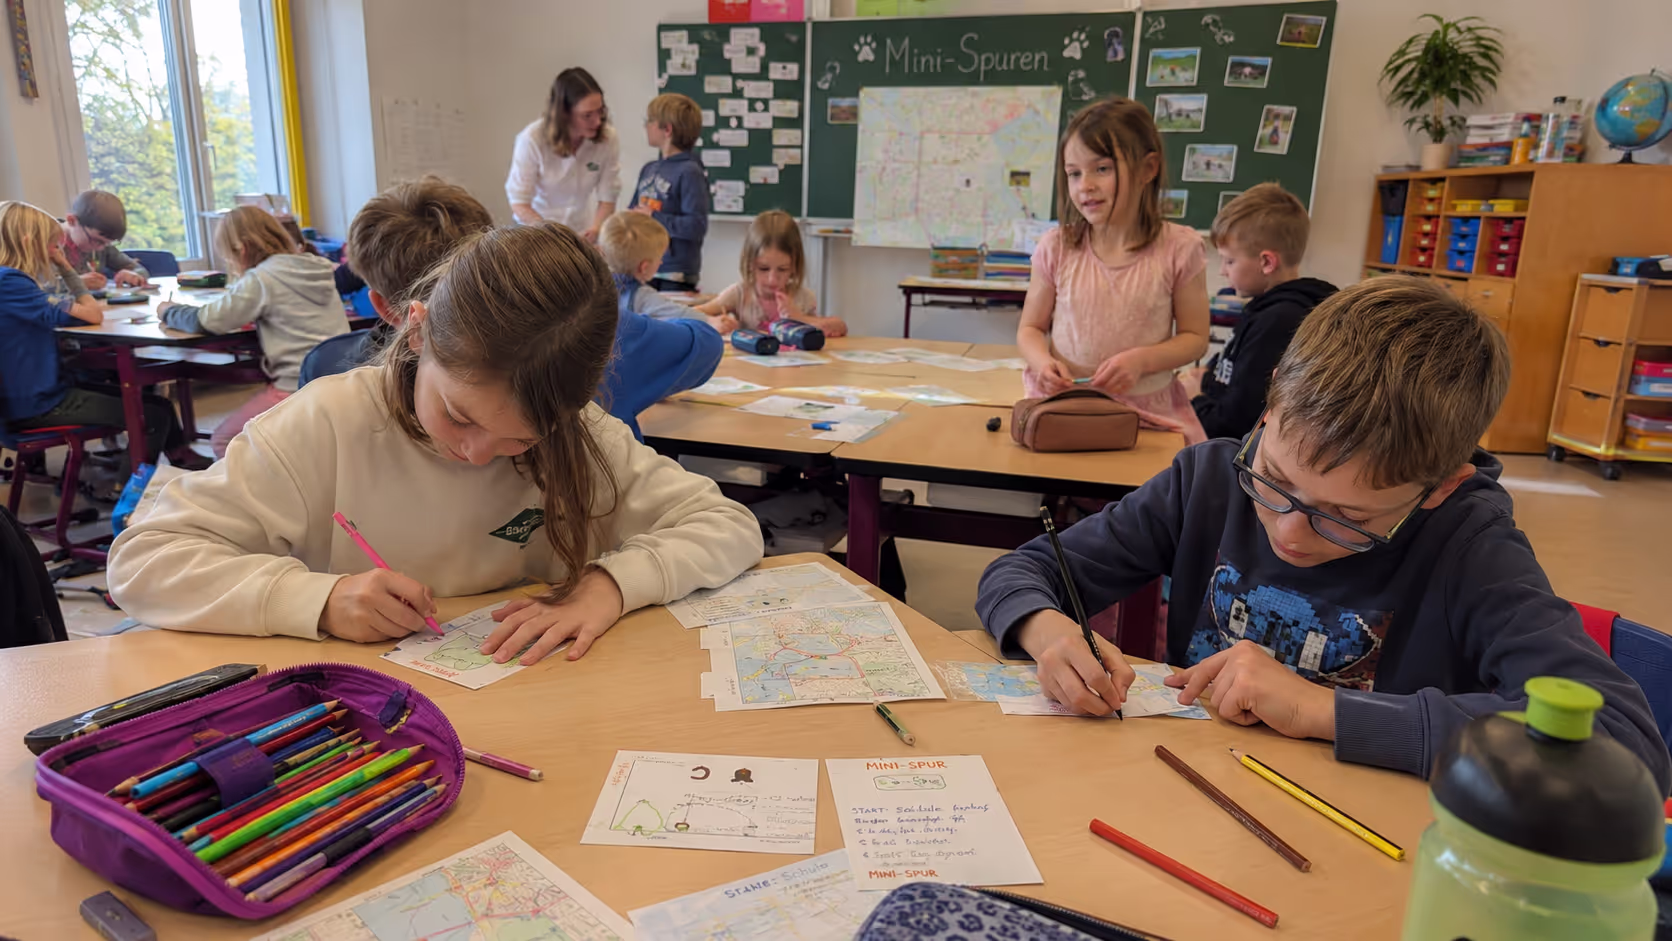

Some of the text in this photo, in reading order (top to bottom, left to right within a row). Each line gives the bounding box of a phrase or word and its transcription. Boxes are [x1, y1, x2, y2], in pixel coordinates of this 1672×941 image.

[885, 32, 1050, 82] Mini-Spuren
[866, 760, 948, 771] MINI-SPUR
[868, 869, 941, 880] MINI-SPUR
